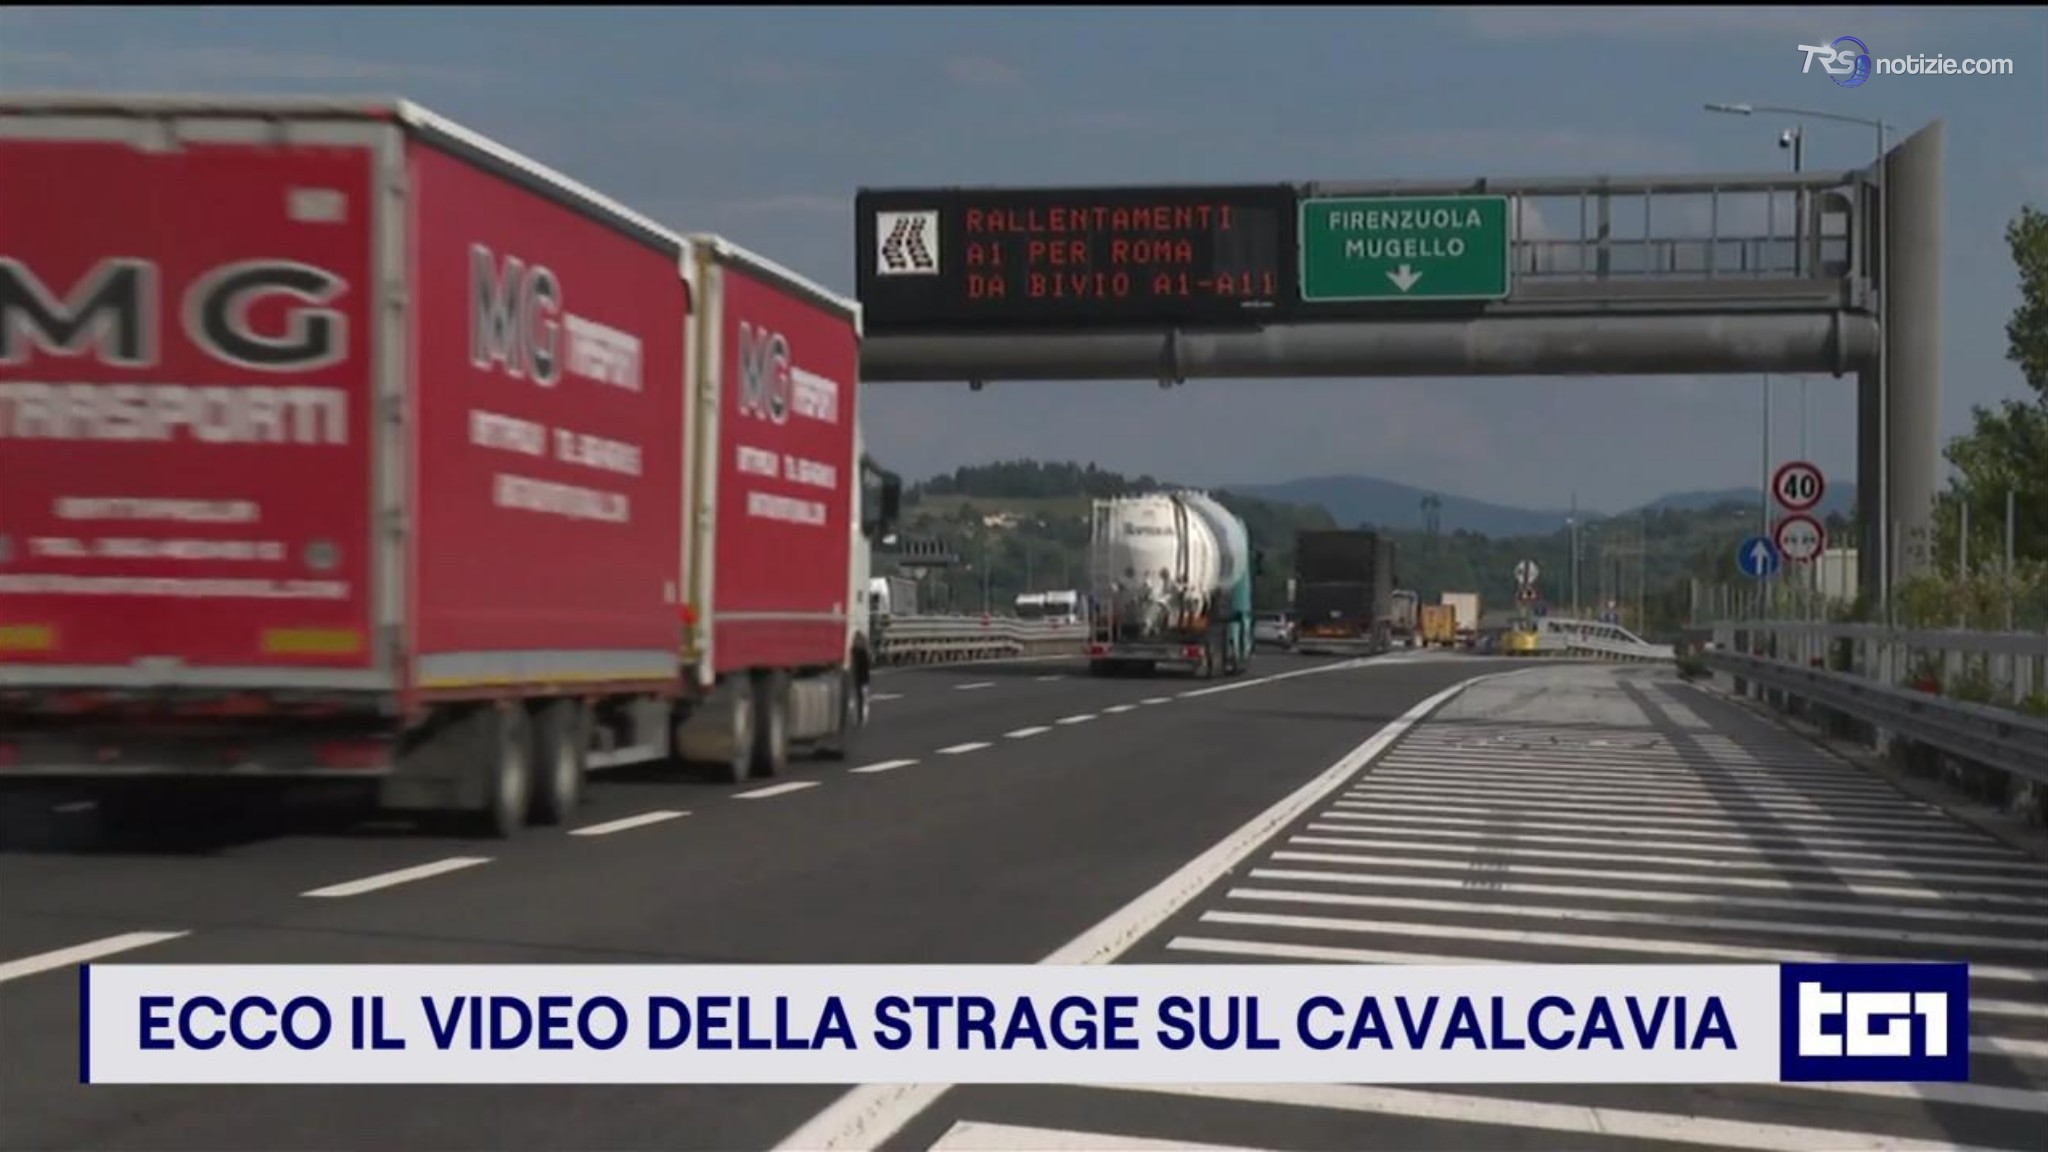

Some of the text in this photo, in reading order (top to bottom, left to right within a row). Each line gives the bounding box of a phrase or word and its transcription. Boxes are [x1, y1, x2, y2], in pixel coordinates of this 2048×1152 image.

[965, 205, 1233, 233] RALLENTAMENTI
[1329, 208, 1481, 231] FIRENZUOLA
[966, 239, 1193, 266] A1 PER ROMA
[1345, 238, 1465, 259] MUGELLO
[967, 271, 1277, 298] DA BIVIO A1-A11
[0, 256, 349, 373] MG
[471, 243, 561, 388] MG
[1783, 474, 1816, 500] 40
